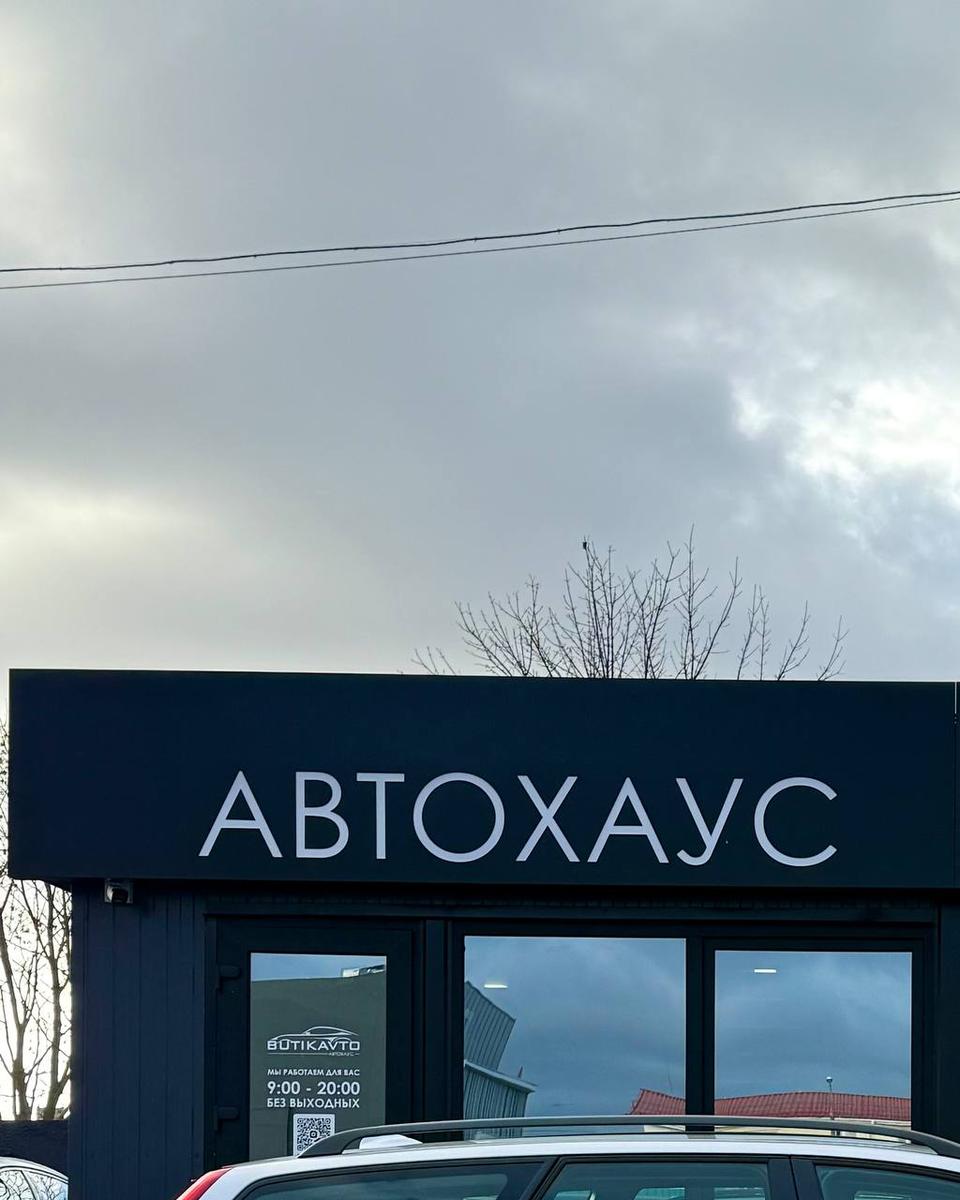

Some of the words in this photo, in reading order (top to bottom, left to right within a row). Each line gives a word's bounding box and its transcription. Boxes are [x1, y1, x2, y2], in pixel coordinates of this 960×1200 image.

[199, 769, 838, 868] АВТОХАУС
[267, 1040, 360, 1050] BUTIKAVTO
[325, 1069, 342, 1077] ДЛЯ
[267, 1081, 301, 1095] 9:00
[317, 1081, 360, 1095] 20:00
[266, 1098, 286, 1108] БЕЗ
[290, 1098, 360, 1109] ВЫХОДНЫХ
